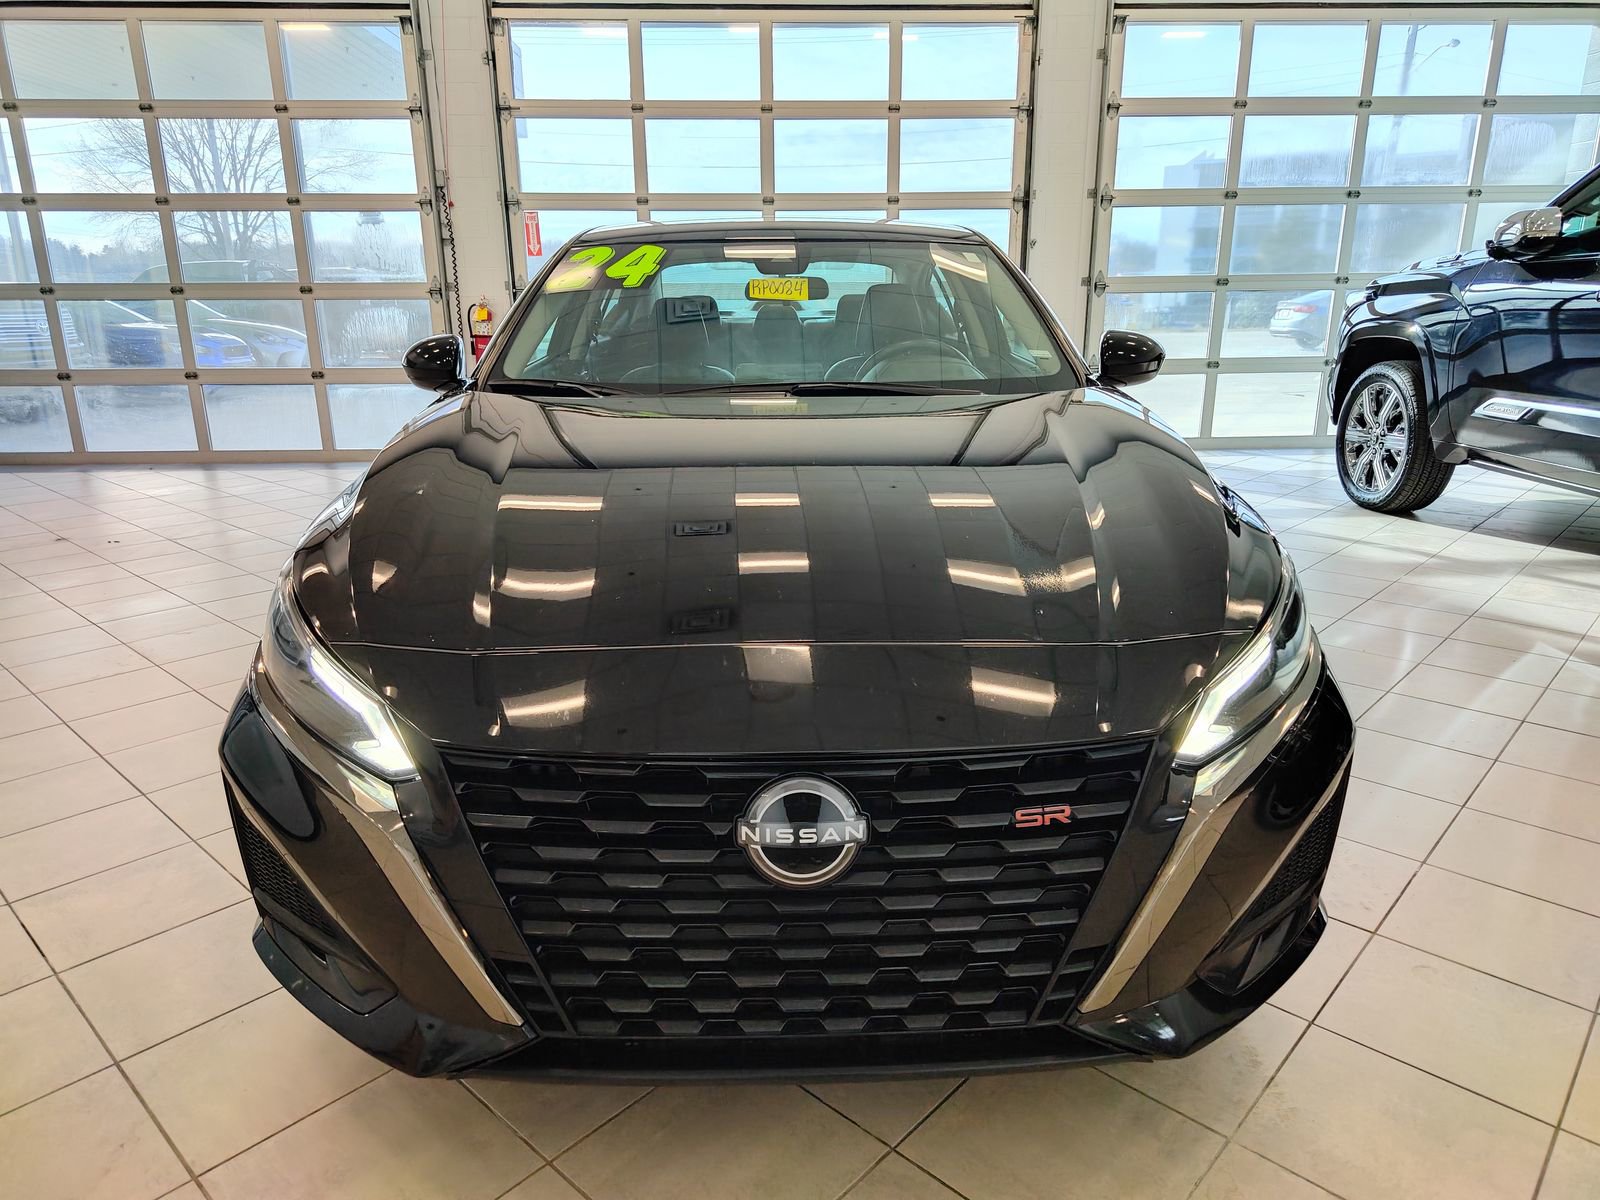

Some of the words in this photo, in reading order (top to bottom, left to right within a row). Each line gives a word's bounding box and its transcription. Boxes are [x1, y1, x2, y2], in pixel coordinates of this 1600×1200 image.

[545, 245, 667, 293] 24
[1015, 804, 1072, 828] SR
[741, 823, 864, 844] NISSAN
